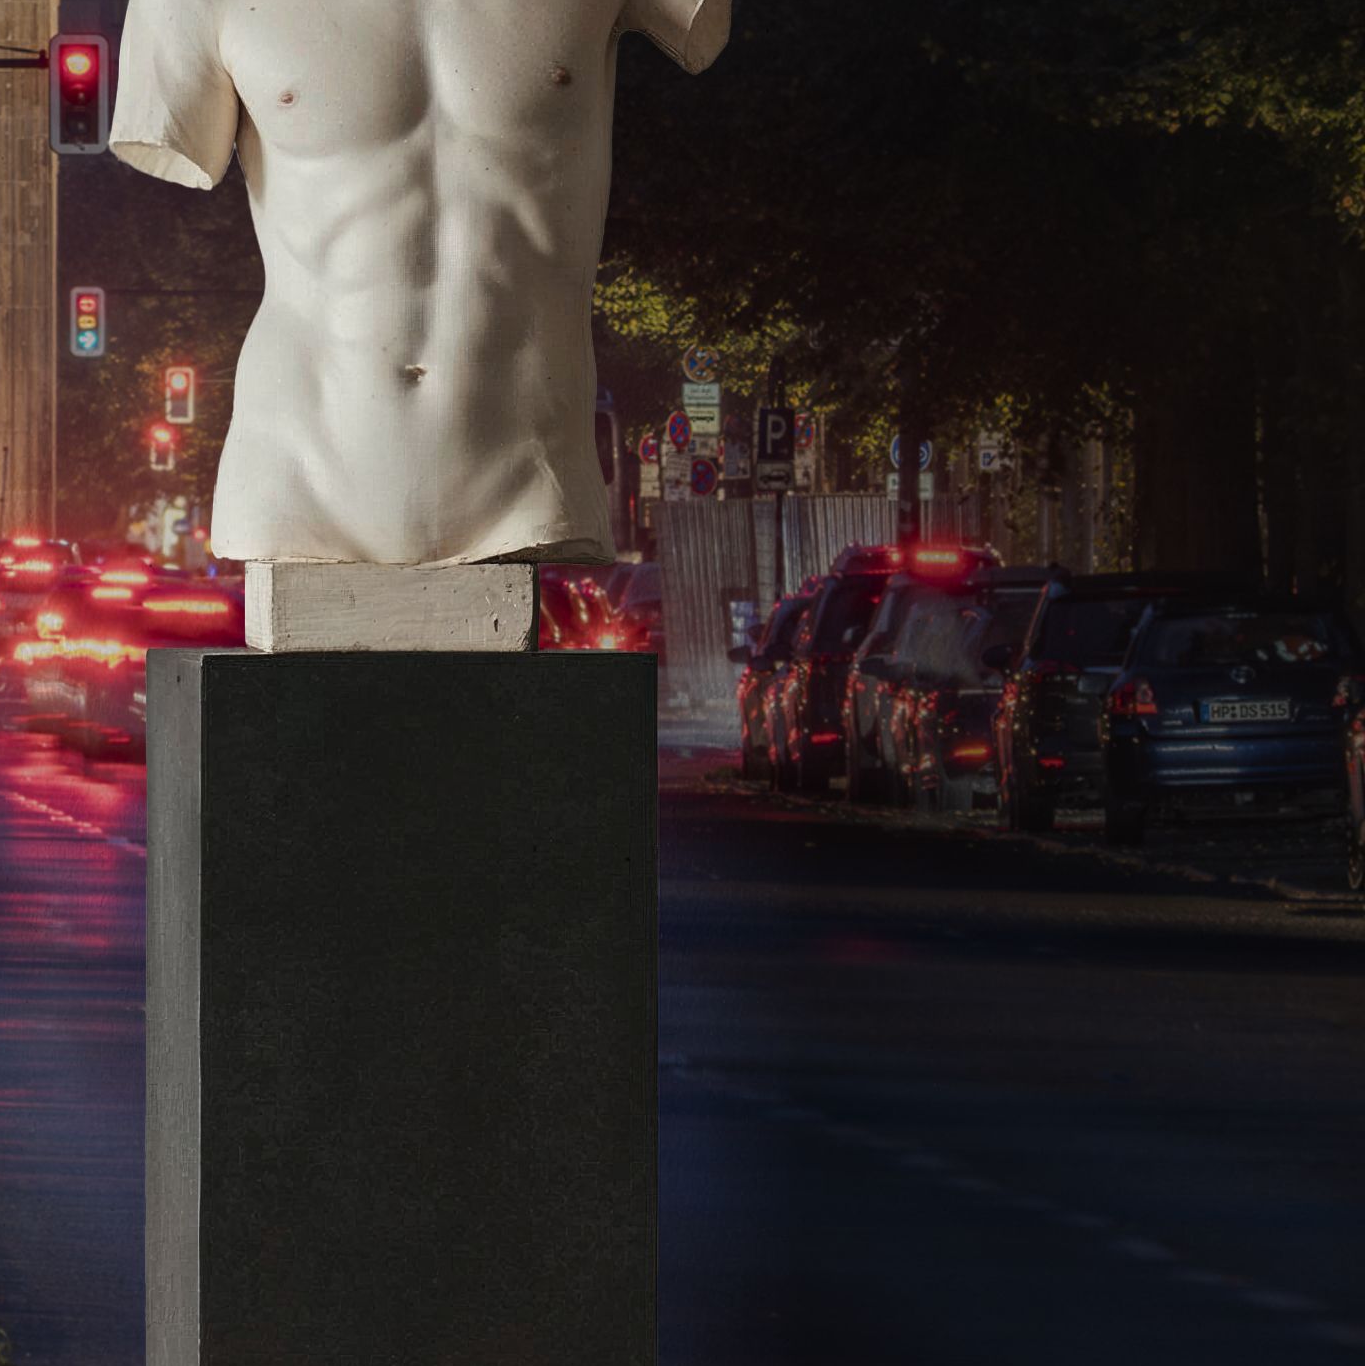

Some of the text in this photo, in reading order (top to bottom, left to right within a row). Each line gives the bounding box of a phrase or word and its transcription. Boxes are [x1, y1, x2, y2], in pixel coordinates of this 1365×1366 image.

[766, 414, 787, 454] P
[1211, 703, 1287, 719] HP DS 515
